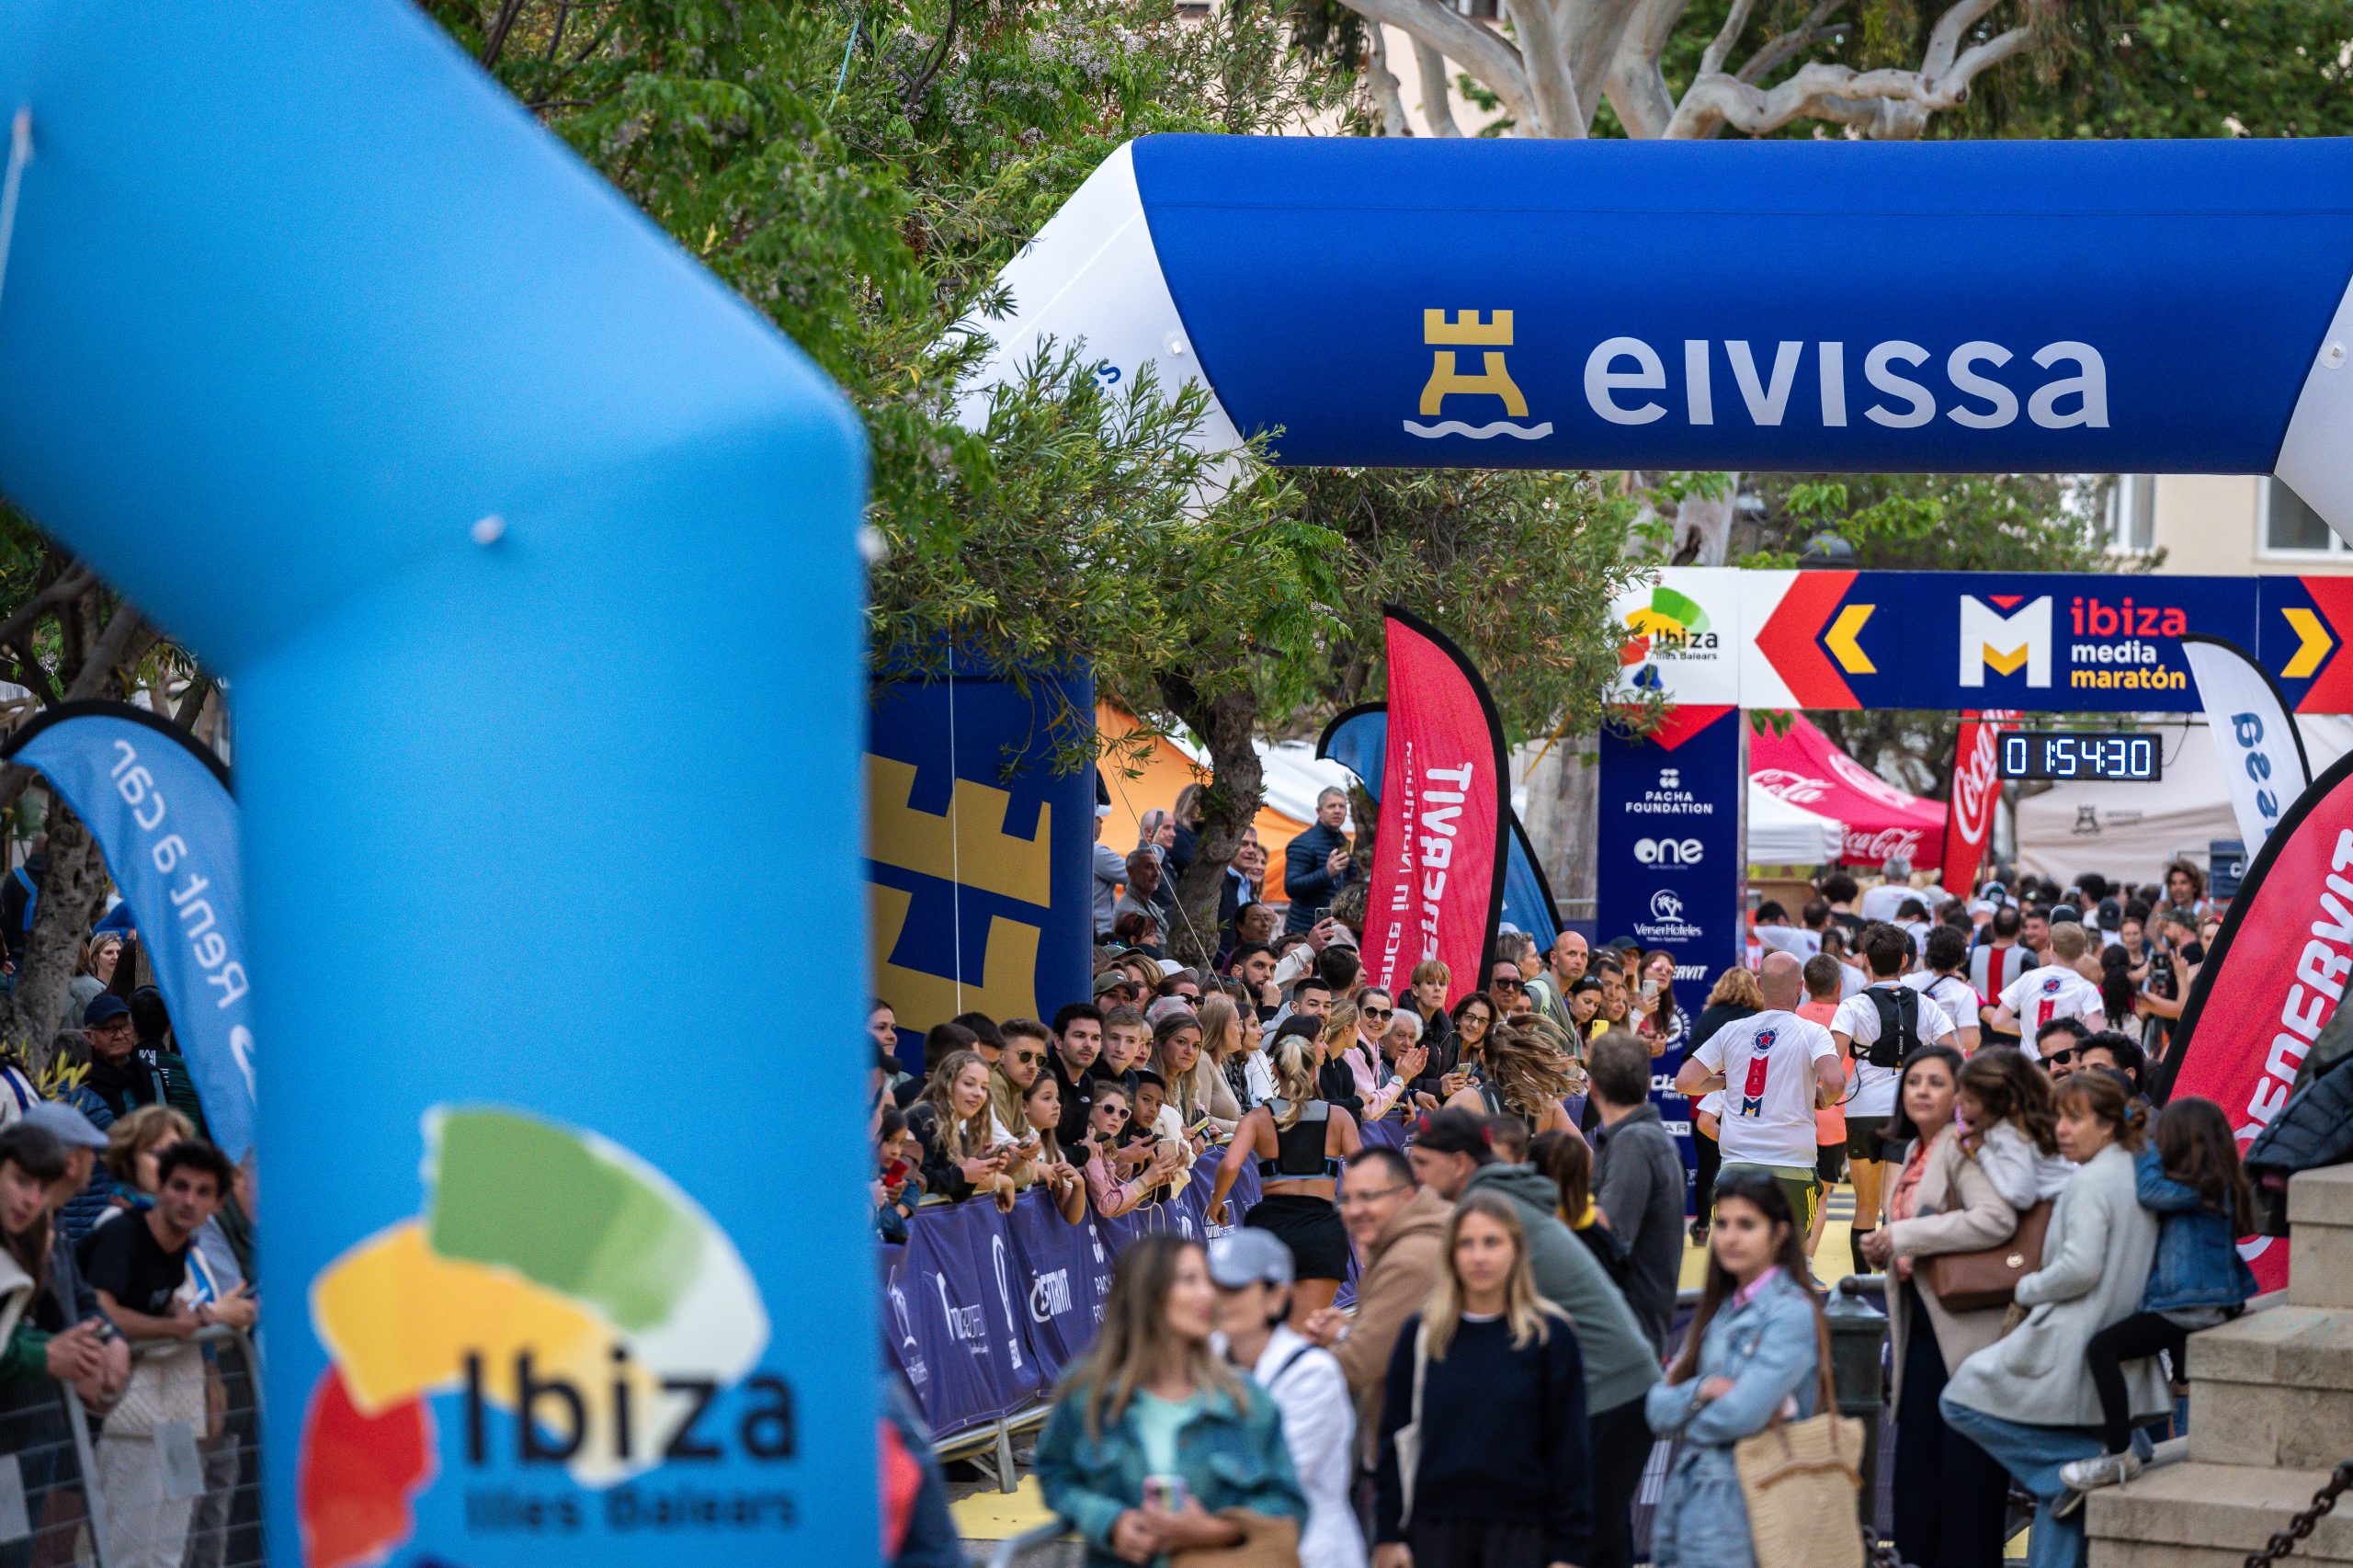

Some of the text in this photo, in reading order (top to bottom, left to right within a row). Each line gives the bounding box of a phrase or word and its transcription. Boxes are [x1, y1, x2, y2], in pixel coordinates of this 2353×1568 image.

[1584, 336, 2110, 429] eivissa
[2071, 597, 2188, 637] ibiza
[1656, 627, 1719, 649] Ibiza
[1679, 651, 1718, 660] Balears
[2071, 640, 2157, 664] media
[2071, 665, 2187, 689] maratón
[1625, 801, 1714, 814] FOUNDATION
[1645, 790, 1694, 802] PACHA
[463, 1346, 800, 1465] Ibiza
